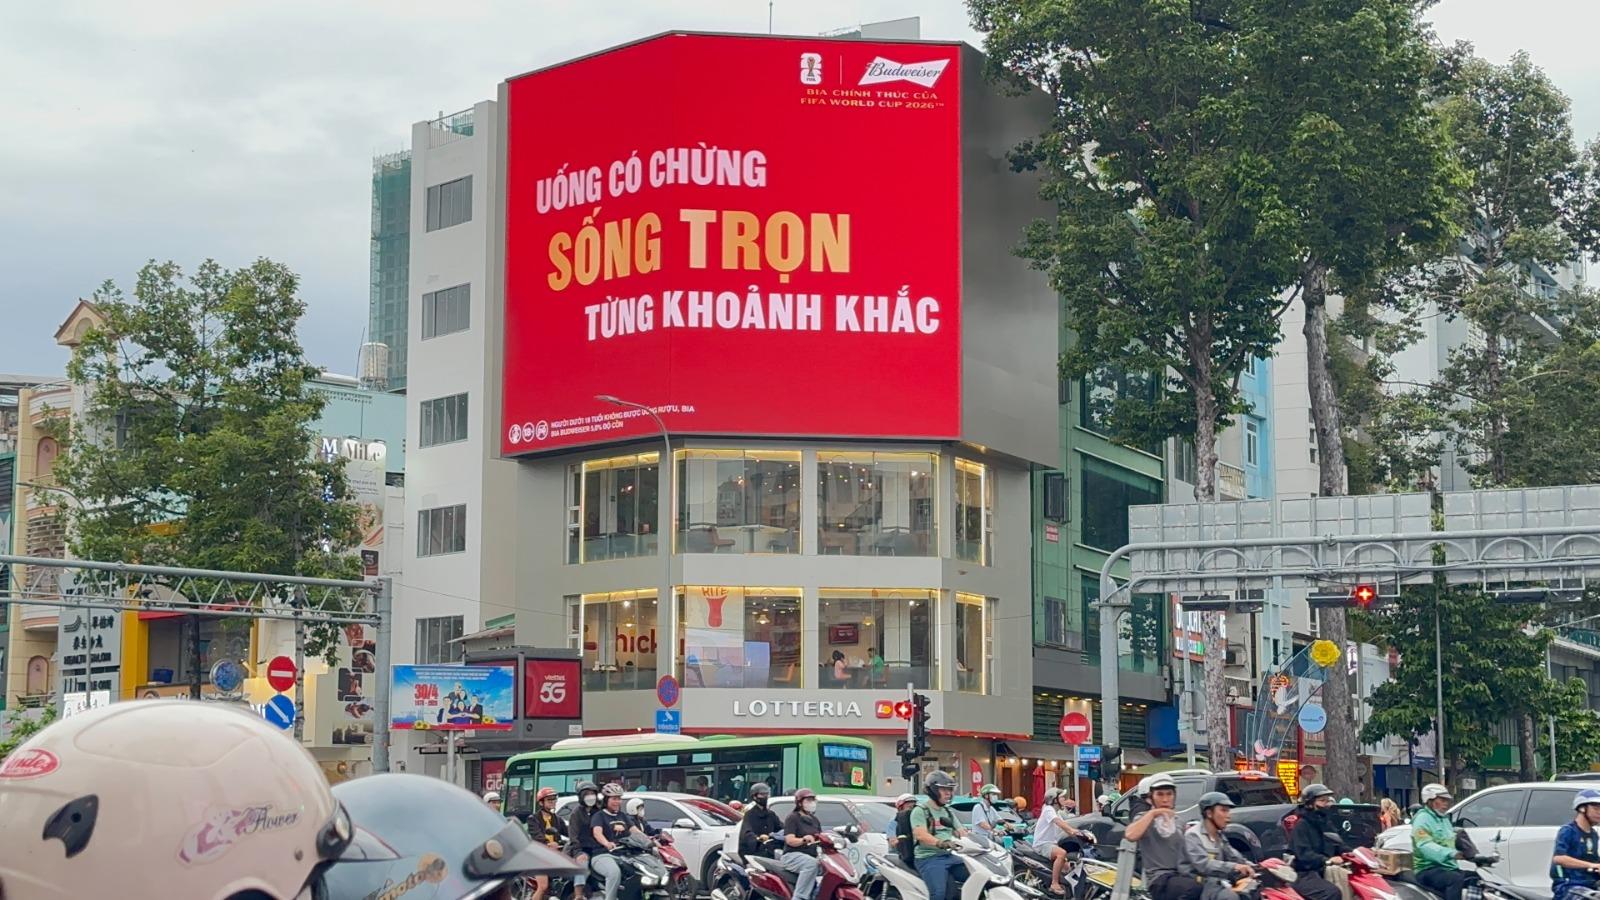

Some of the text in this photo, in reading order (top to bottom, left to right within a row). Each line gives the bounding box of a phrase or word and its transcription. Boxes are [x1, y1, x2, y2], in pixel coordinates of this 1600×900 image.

[866, 62, 941, 78] Budweiser
[801, 97, 827, 105] FIFA
[830, 98, 875, 107] WORLD
[878, 99, 902, 108] CUP
[807, 88, 828, 96] BIA
[832, 88, 871, 97] CHÍNH
[913, 91, 938, 99] CỦA
[536, 141, 767, 214] UỐNG CÓ CHỪNG
[547, 206, 851, 291] SỐNG TRỌN
[585, 284, 940, 341] TỪNG KHOẢNH KHẮC
[682, 404, 695, 413] BIA
[539, 682, 566, 704] 5G
[733, 699, 862, 717] LOTTERIA
